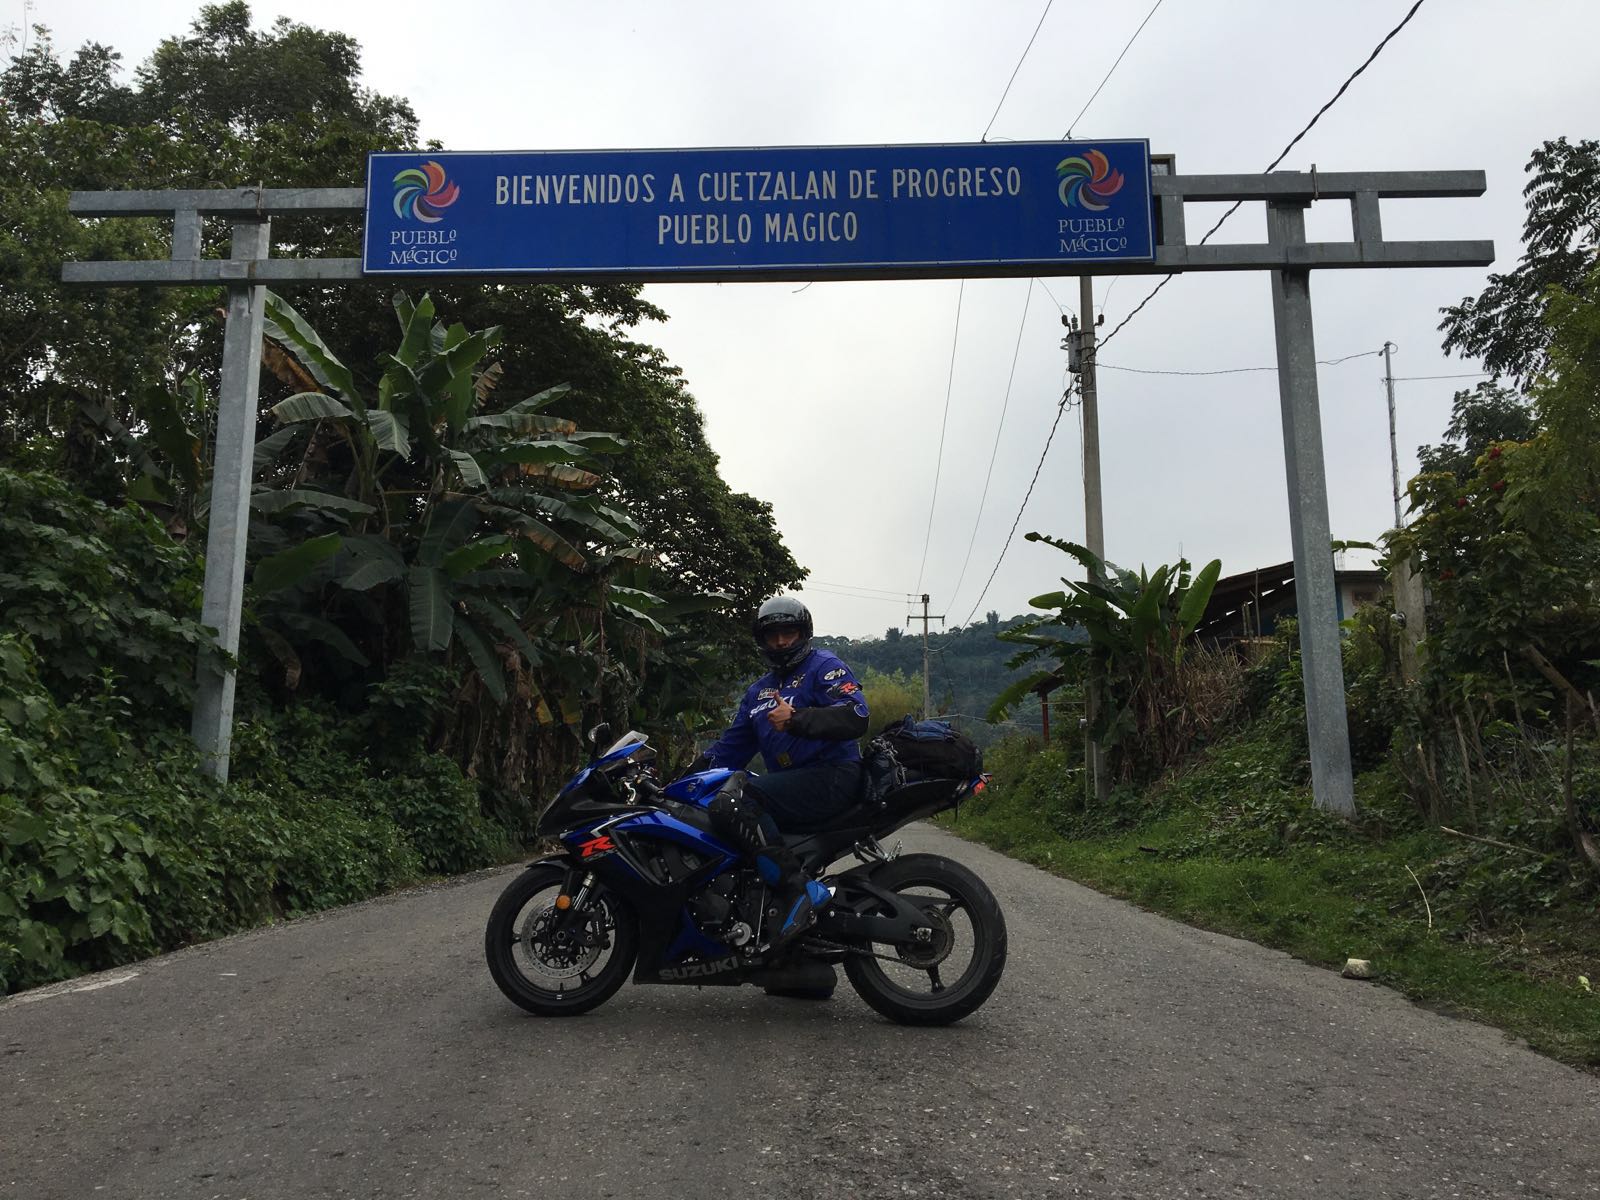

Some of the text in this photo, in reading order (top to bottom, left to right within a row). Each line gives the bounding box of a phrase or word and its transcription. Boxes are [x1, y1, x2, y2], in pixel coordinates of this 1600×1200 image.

[495, 166, 1021, 205] BIENVENIDOS A CUETZALAN DE PROGRESO
[658, 211, 857, 245] PUEBLO MAGICO
[658, 956, 739, 981] SUZUKI
